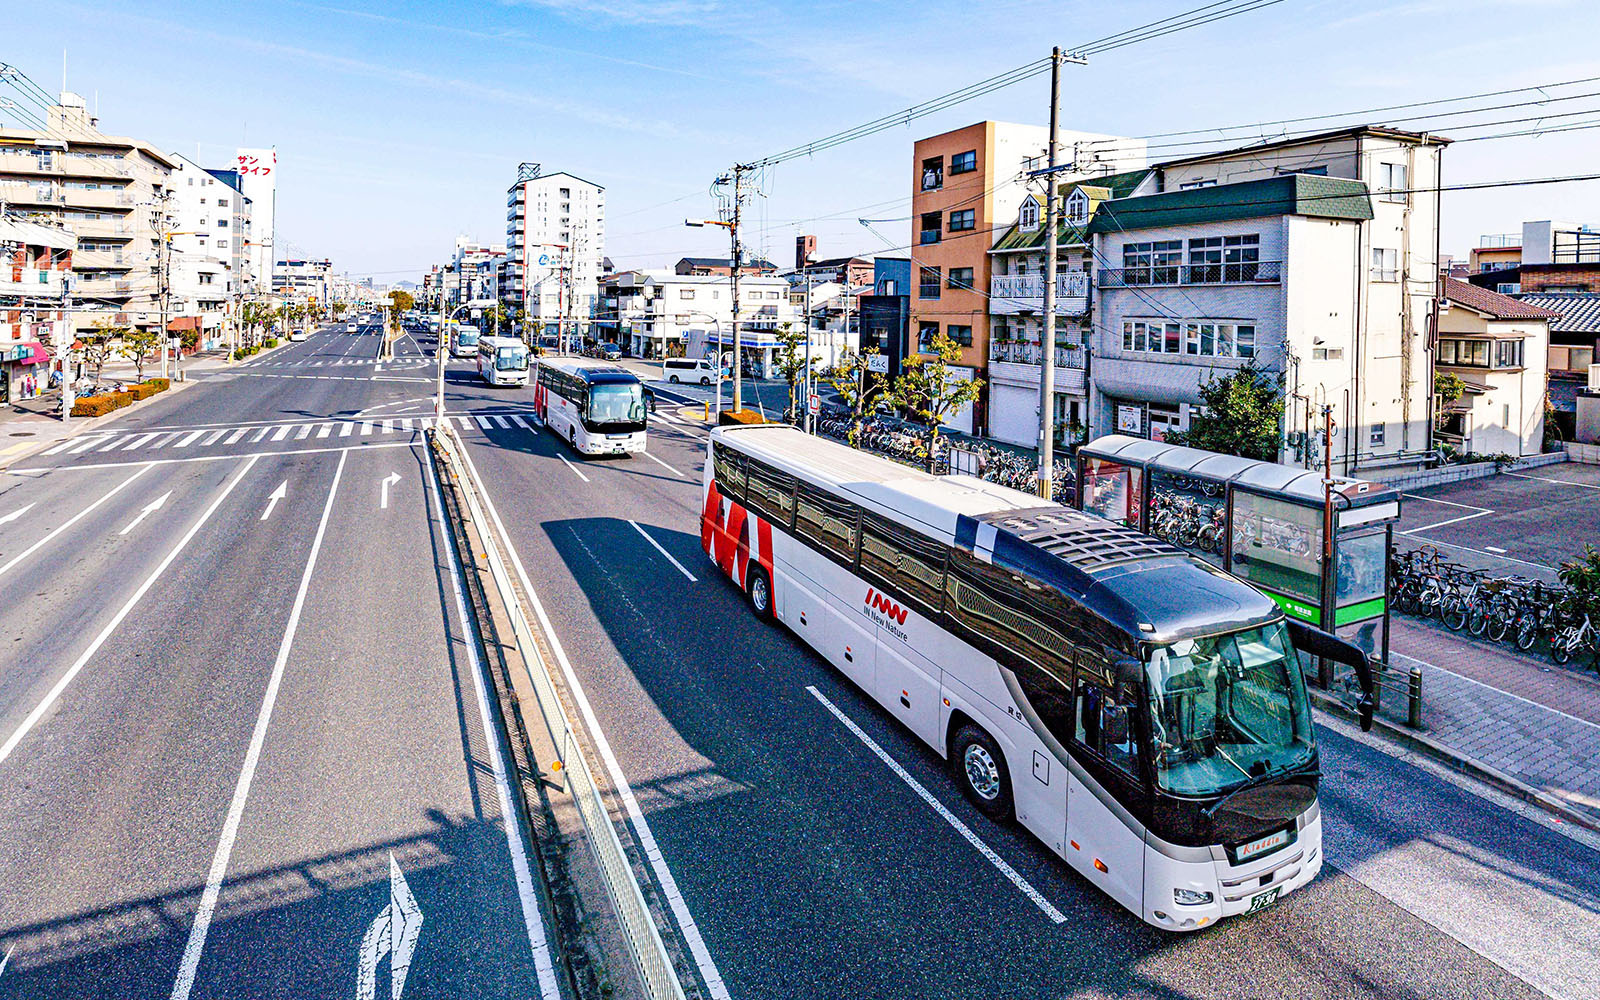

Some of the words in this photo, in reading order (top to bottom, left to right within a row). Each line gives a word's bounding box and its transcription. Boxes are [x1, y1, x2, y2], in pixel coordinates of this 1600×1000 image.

[238, 155, 258, 164] サン
[240, 166, 271, 175] ライフ
[864, 605, 870, 617] IN
[871, 611, 885, 626] New
[885, 619, 908, 642] Nature
